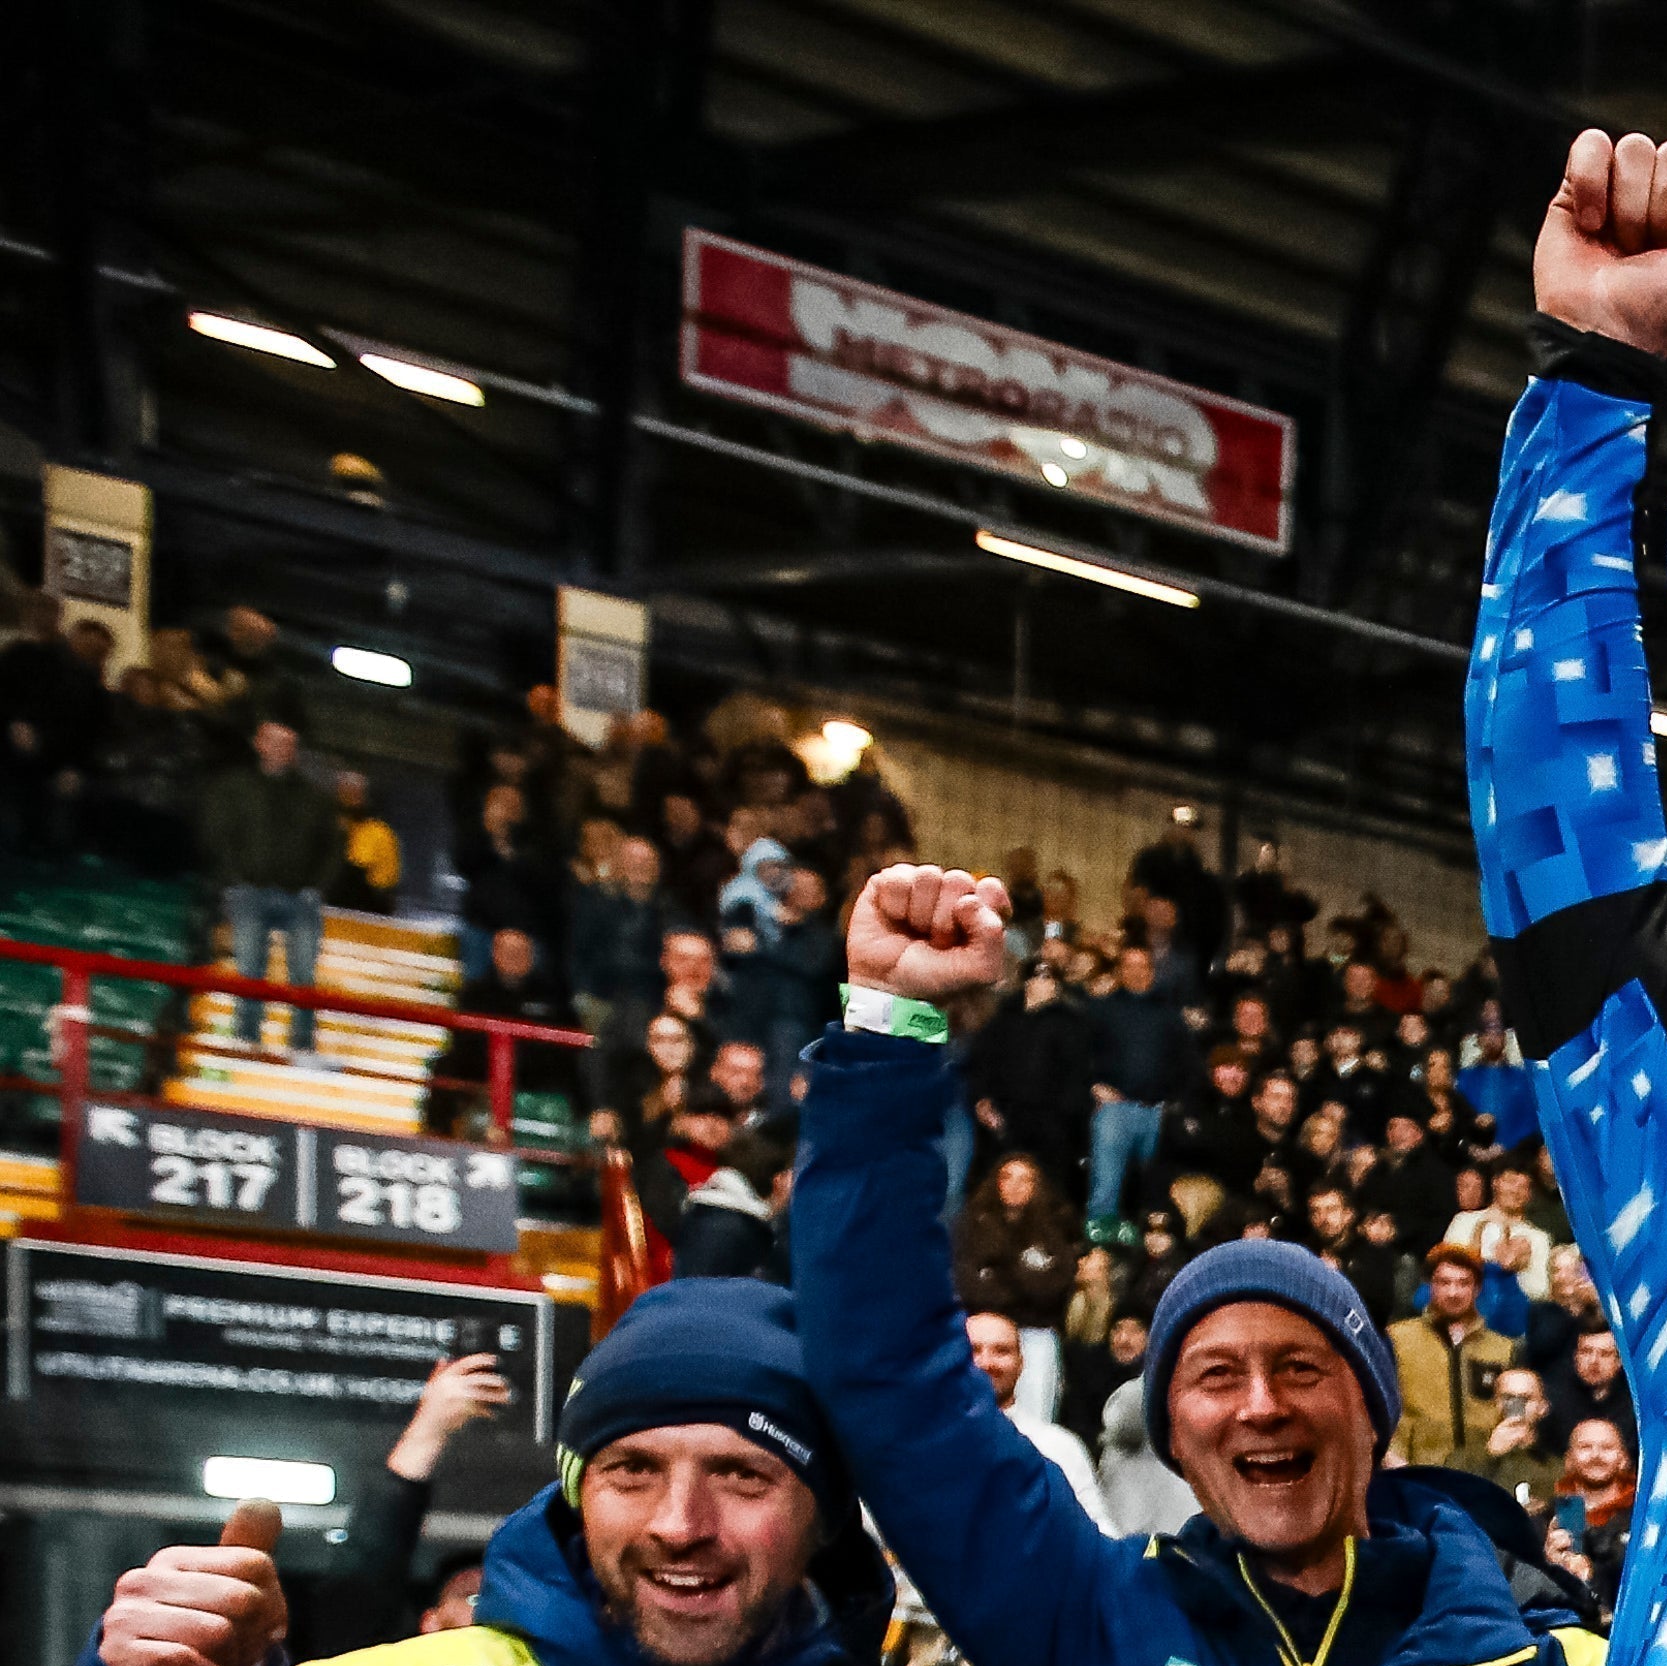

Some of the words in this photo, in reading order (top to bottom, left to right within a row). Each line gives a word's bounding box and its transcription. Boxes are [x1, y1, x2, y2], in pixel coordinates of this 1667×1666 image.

[148, 1122, 280, 1164] BLOCK
[333, 1143, 457, 1186] BLOCK
[150, 1155, 277, 1211] 217
[337, 1177, 462, 1234] 218
[162, 1293, 319, 1331] PREMIUM
[326, 1307, 521, 1352] EXPERIEE
